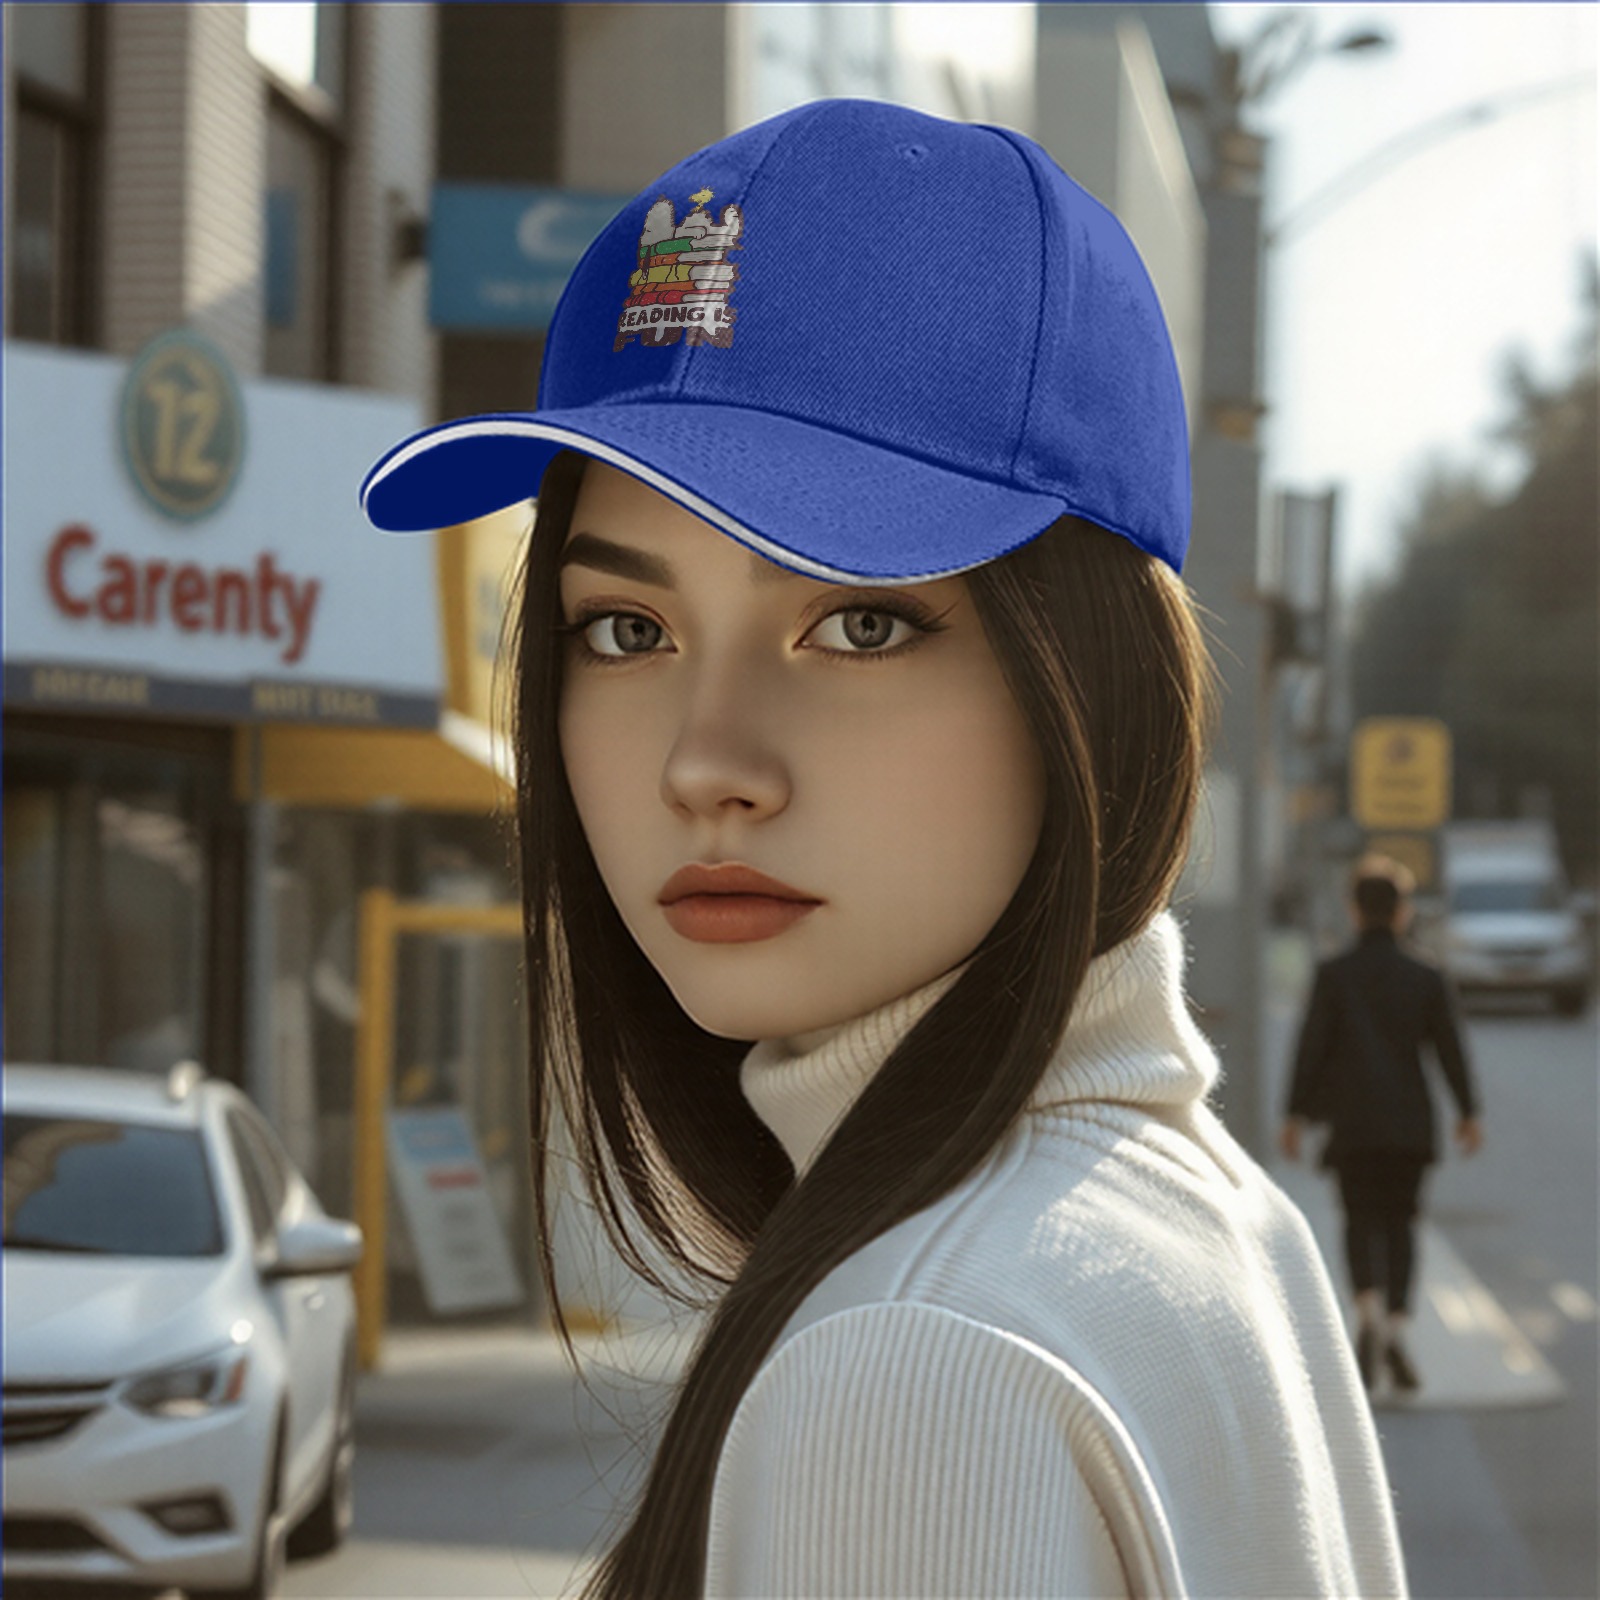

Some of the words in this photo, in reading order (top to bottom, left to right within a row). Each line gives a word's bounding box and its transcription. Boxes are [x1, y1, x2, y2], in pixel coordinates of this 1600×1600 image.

[618, 306, 706, 328] READING
[713, 306, 738, 325] IS
[45, 524, 321, 664] Carenty
